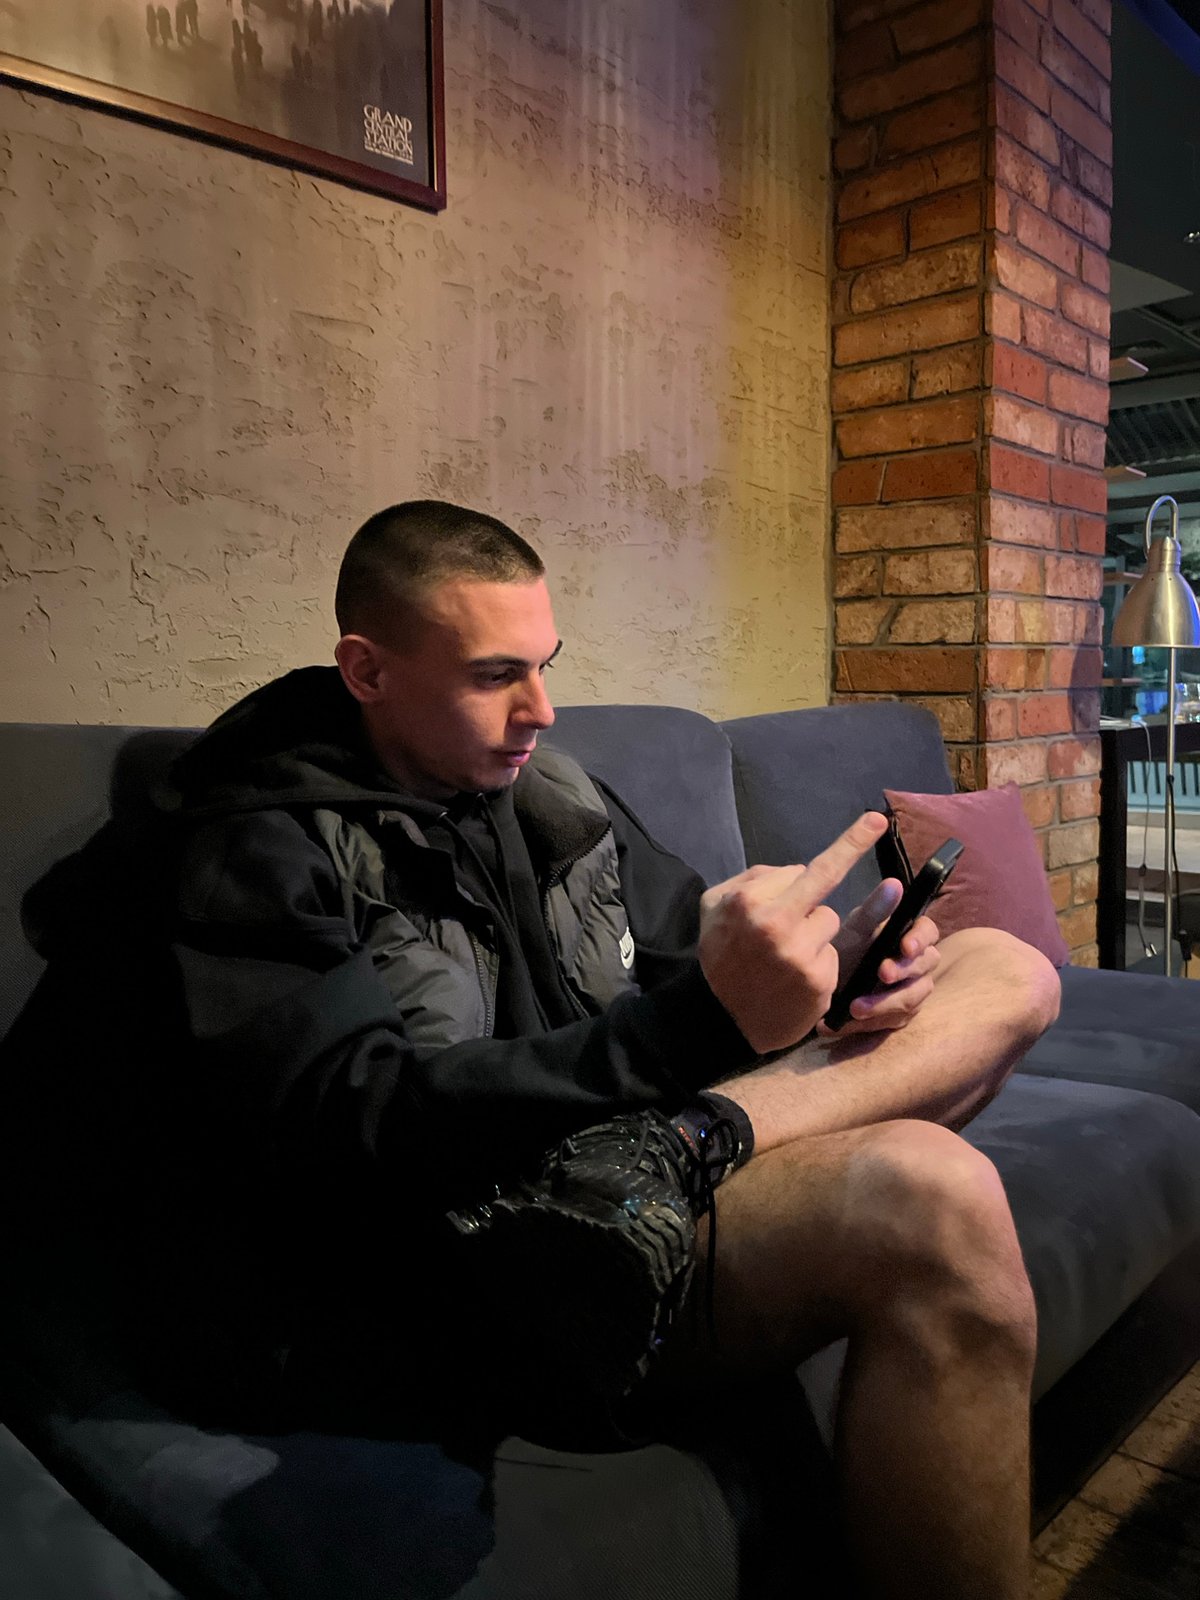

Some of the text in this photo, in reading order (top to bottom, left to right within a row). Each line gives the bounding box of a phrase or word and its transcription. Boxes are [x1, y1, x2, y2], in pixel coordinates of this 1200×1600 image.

[363, 104, 413, 133] GRAND
[364, 118, 410, 144] CENTRAL
[364, 129, 413, 156] STATION
